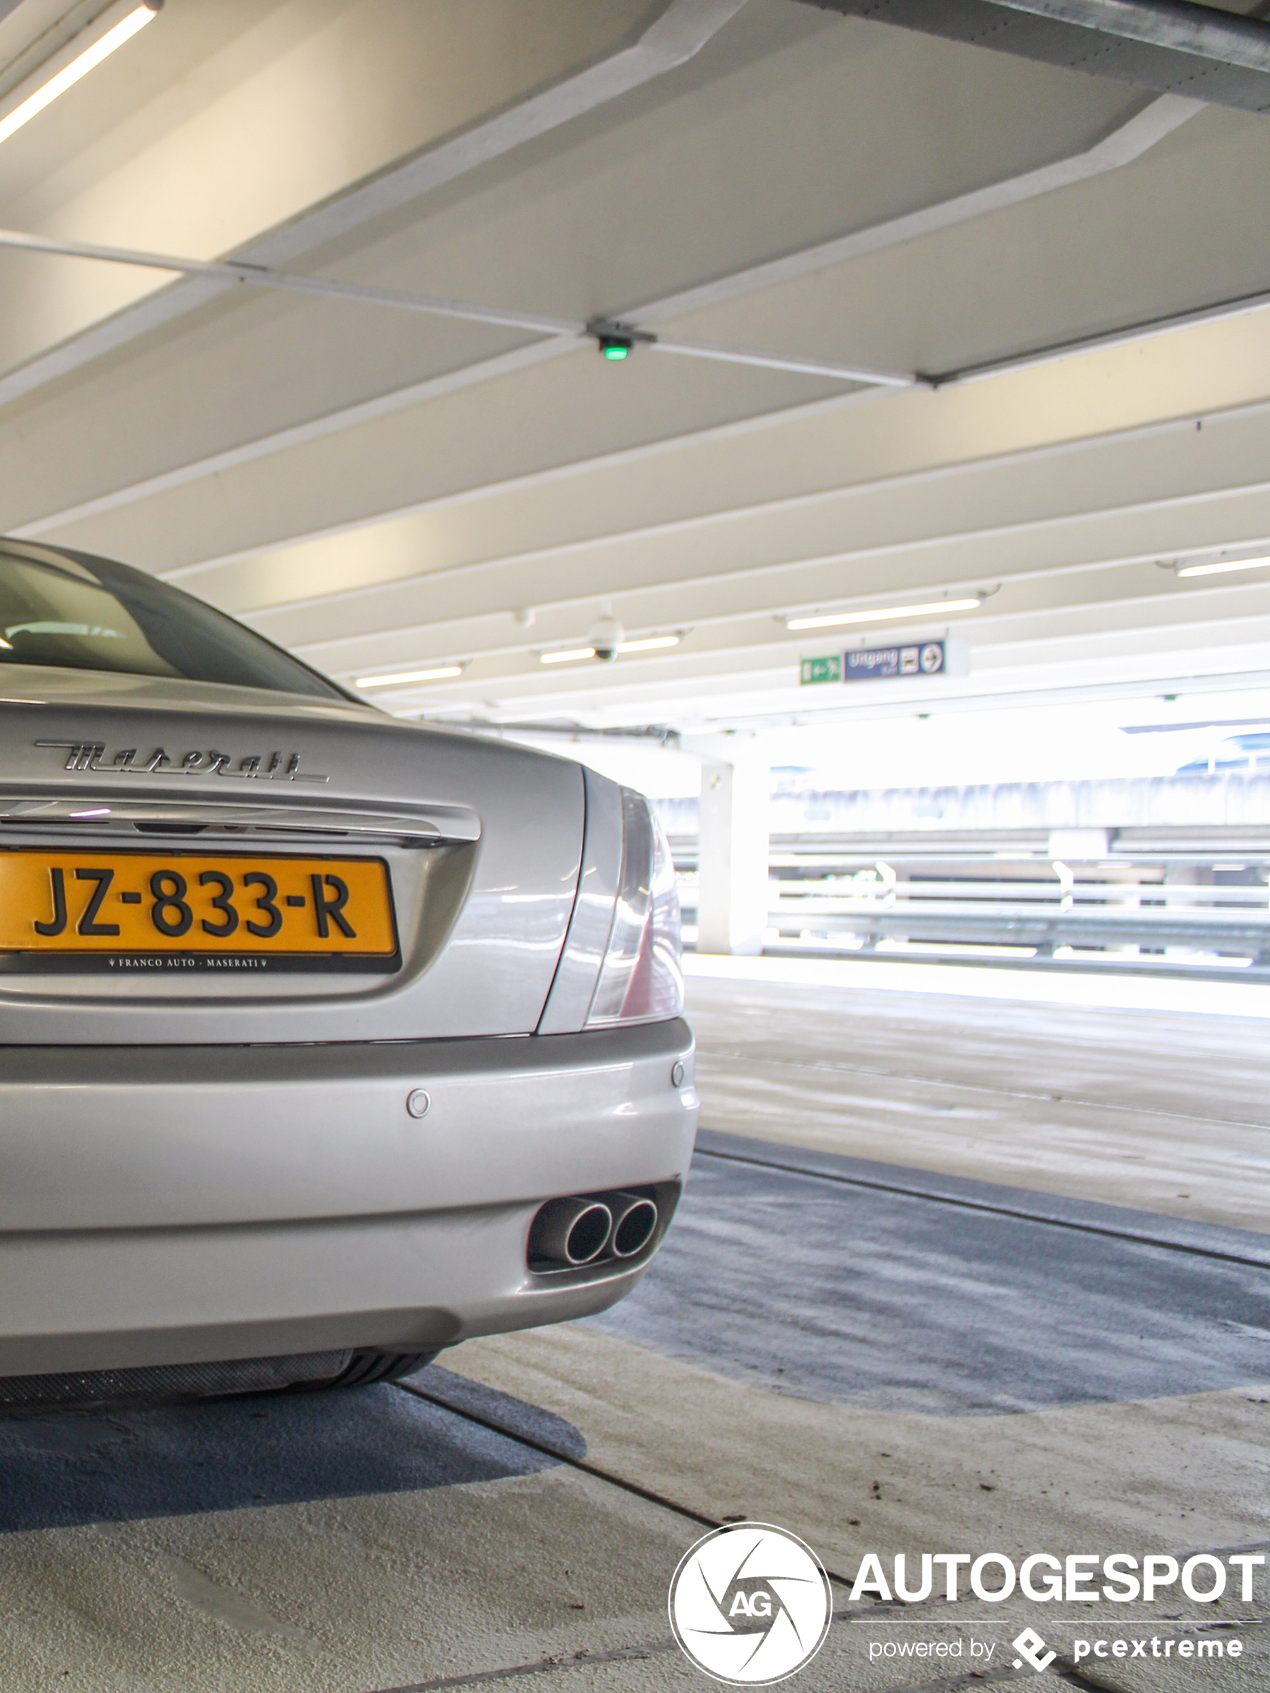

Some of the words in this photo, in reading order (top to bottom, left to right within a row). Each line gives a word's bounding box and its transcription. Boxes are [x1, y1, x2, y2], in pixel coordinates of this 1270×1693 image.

[849, 650, 898, 669] Uitgang
[34, 739, 330, 782] Maserati
[33, 867, 357, 939] JZ-833-R
[118, 958, 163, 967] FRANCO
[166, 958, 196, 967] AUTO
[207, 958, 260, 967] MASERATI
